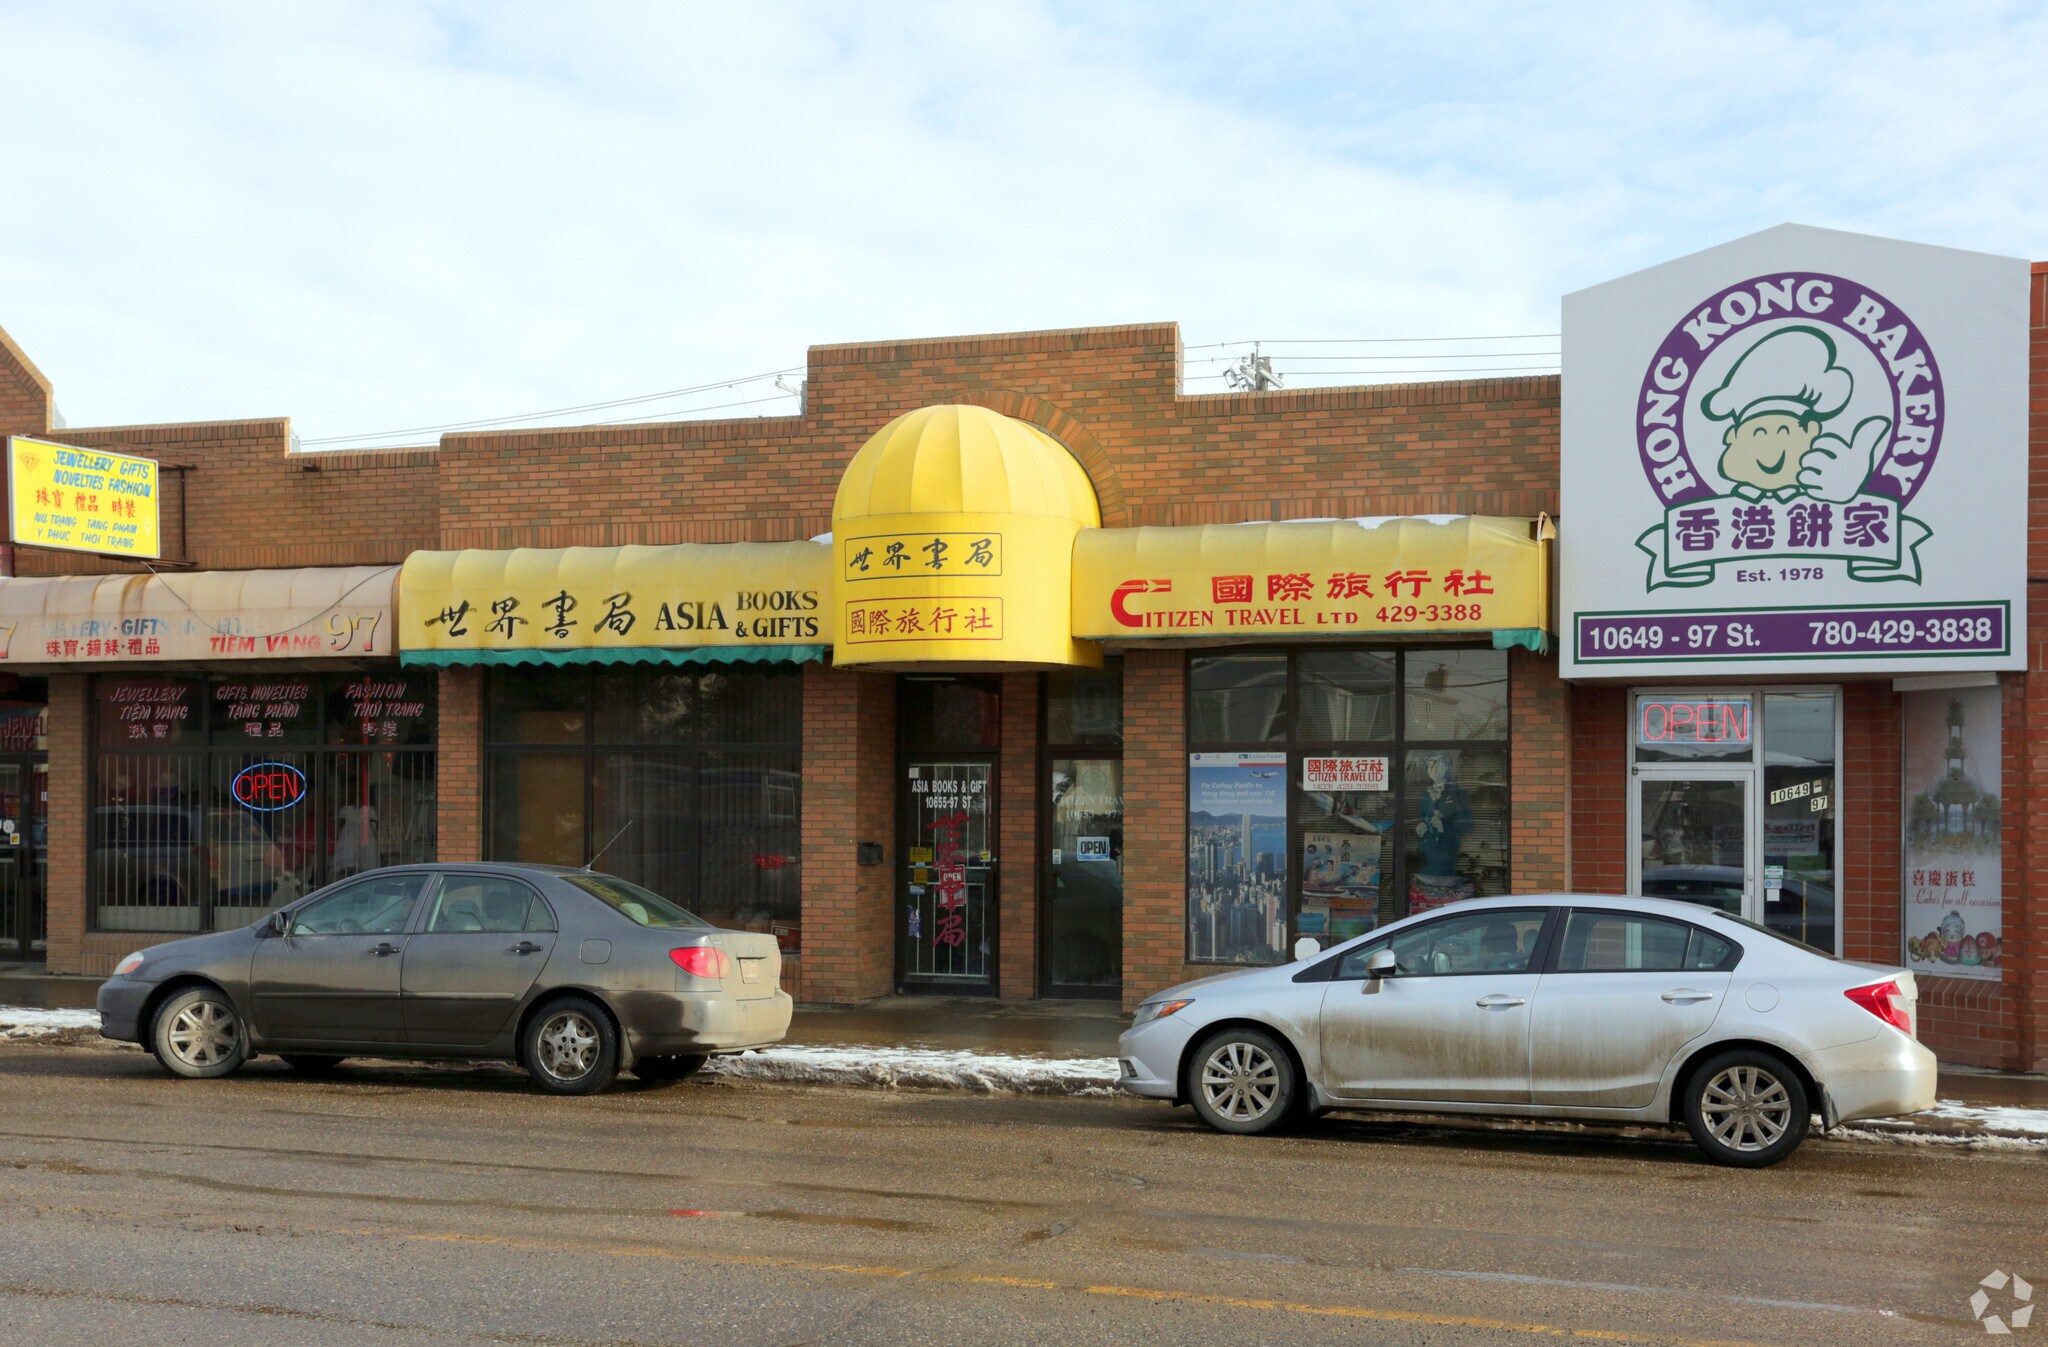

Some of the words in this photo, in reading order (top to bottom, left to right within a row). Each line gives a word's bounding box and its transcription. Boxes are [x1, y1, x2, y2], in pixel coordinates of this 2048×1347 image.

[1642, 356, 1696, 500] HONG
[1683, 278, 1833, 351] KONG
[1843, 294, 1936, 496] BAKERY
[53, 450, 115, 473] JEWELLERY
[120, 461, 150, 479] GIFTS
[53, 469, 104, 490] NOVELTIES
[108, 478, 151, 497] FASHION
[36, 487, 64, 509] 珠寶
[74, 491, 99, 512] 禮品
[111, 497, 136, 518] 時裝
[50, 514, 77, 528] TRANG
[1675, 502, 1890, 552] 香港餅家
[107, 535, 134, 549] TRANG
[849, 537, 994, 572] 世界書局
[1736, 569, 1771, 583] Est.
[1779, 567, 1824, 582] 1978
[1211, 568, 1494, 604] 國際旅行社
[424, 589, 636, 640] 世界書局
[654, 601, 729, 631] ASIA
[736, 589, 819, 612] BOOKS
[850, 606, 994, 635] 國際旅行社
[1224, 607, 1305, 626] TRAVEL
[1316, 611, 1359, 625] LTD
[1375, 603, 1482, 623] 429-3388
[324, 611, 382, 652] 97
[735, 620, 748, 638] &
[752, 616, 819, 638] GIFTS
[1589, 626, 1663, 650] 10649
[1687, 624, 1718, 648] 97
[1727, 623, 1760, 647] St.
[1809, 617, 1992, 646] 780-429-3838
[110, 687, 187, 702] JEWELLERY
[251, 685, 309, 700] NOVELTIES
[345, 683, 406, 699] FASHION
[385, 703, 425, 717] TRANG
[2, 716, 48, 737] JEWEL
[1642, 704, 1748, 741] OPEN
[1308, 759, 1384, 772] 國際旅行社
[235, 774, 299, 801] OPEN
[912, 780, 929, 793] ASIA
[932, 780, 958, 793] BOOKS
[961, 780, 967, 793] &
[1308, 773, 1337, 782] CITIZEN
[1340, 773, 1366, 782] TRAVEL
[1368, 773, 1383, 782] LTD
[925, 796, 958, 808] 10655-97
[962, 796, 973, 808] ST
[1772, 783, 1809, 803] 10649
[1812, 797, 1826, 810] 97
[1080, 841, 1106, 854] OPEN
[1913, 870, 1976, 887] 喜慶蛋糕
[1917, 888, 1940, 904] Cakes
[1941, 889, 1953, 909] for
[1955, 889, 1970, 905] all
